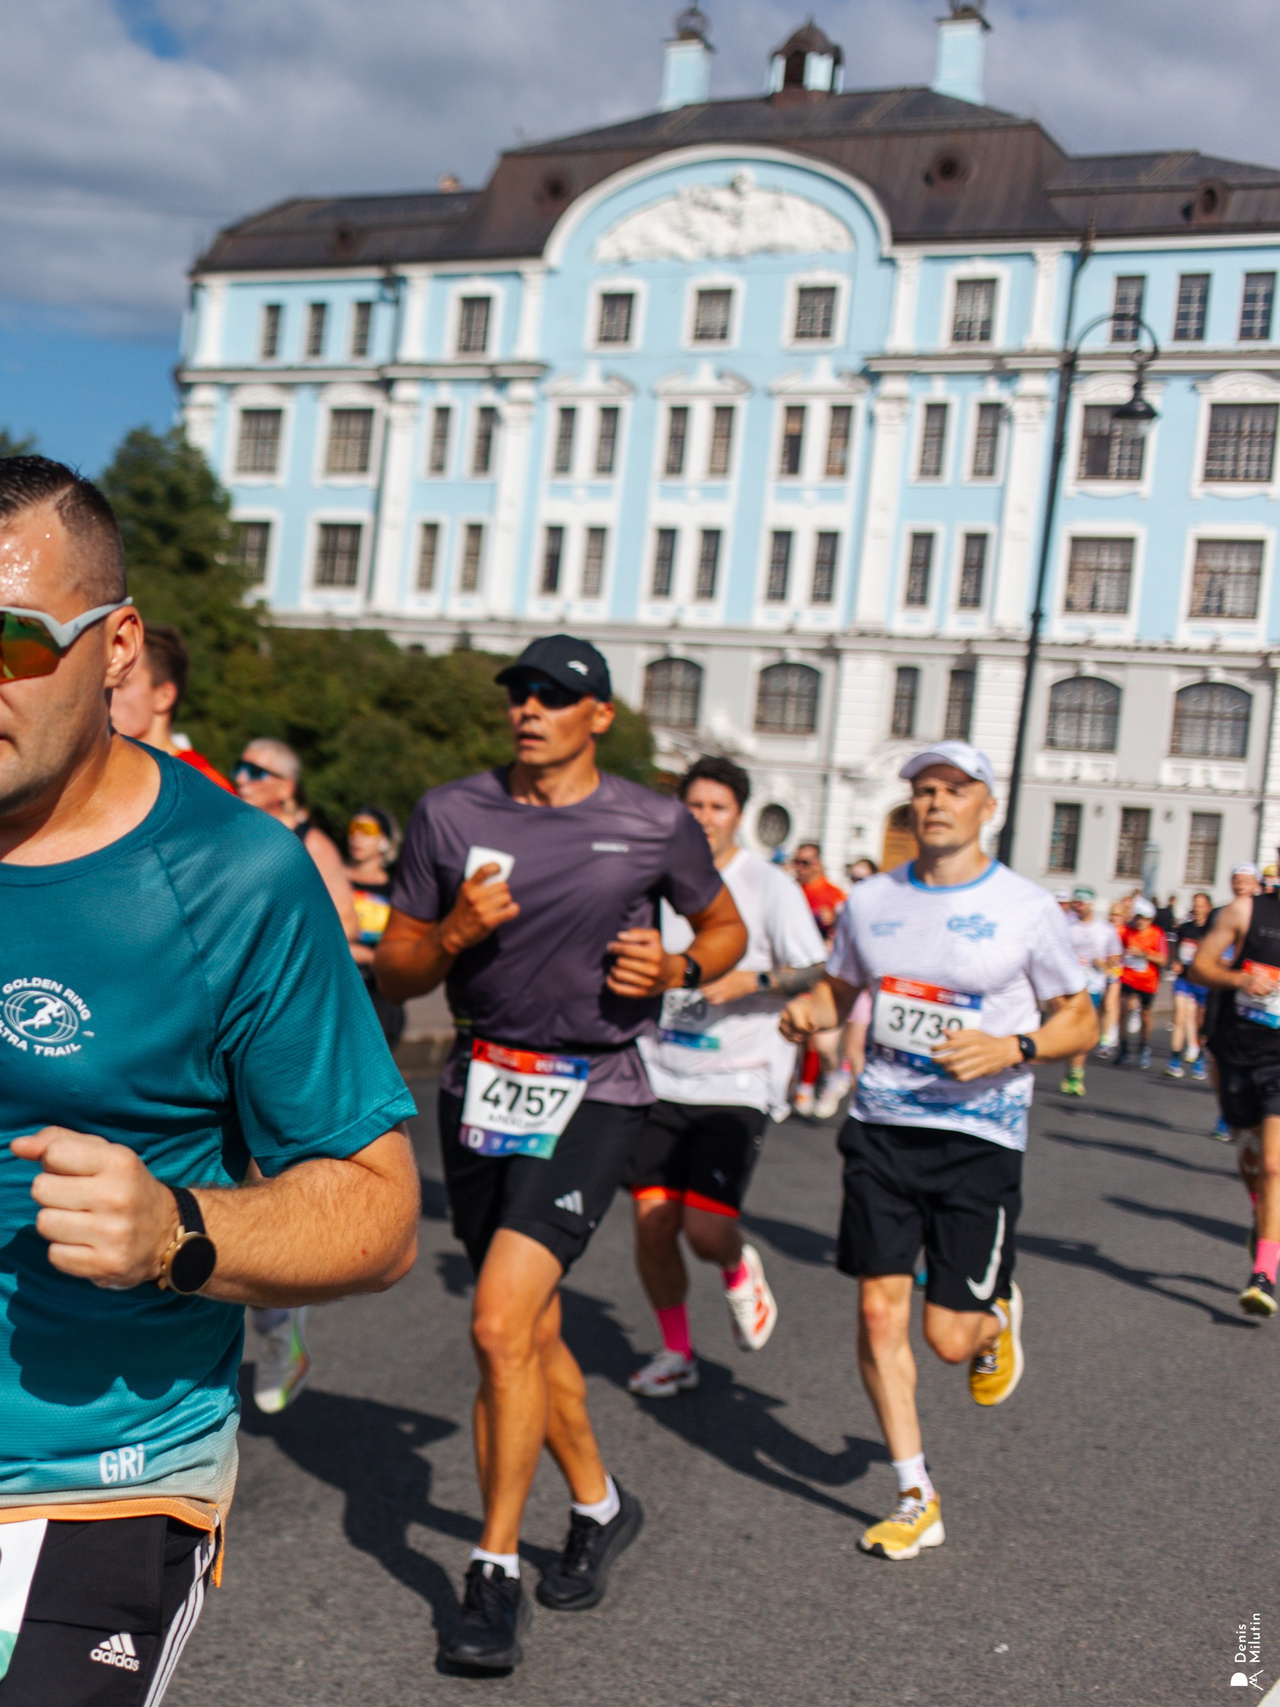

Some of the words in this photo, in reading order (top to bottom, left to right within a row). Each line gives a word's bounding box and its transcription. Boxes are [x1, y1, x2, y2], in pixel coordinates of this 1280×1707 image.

[2, 977, 63, 995] GOLDEN
[62, 988, 91, 1021] RING
[33, 1042, 82, 1057] TRAIL
[482, 1077, 570, 1117] 4757
[99, 1443, 145, 1484] GRi
[90, 1648, 140, 1672] adidas
